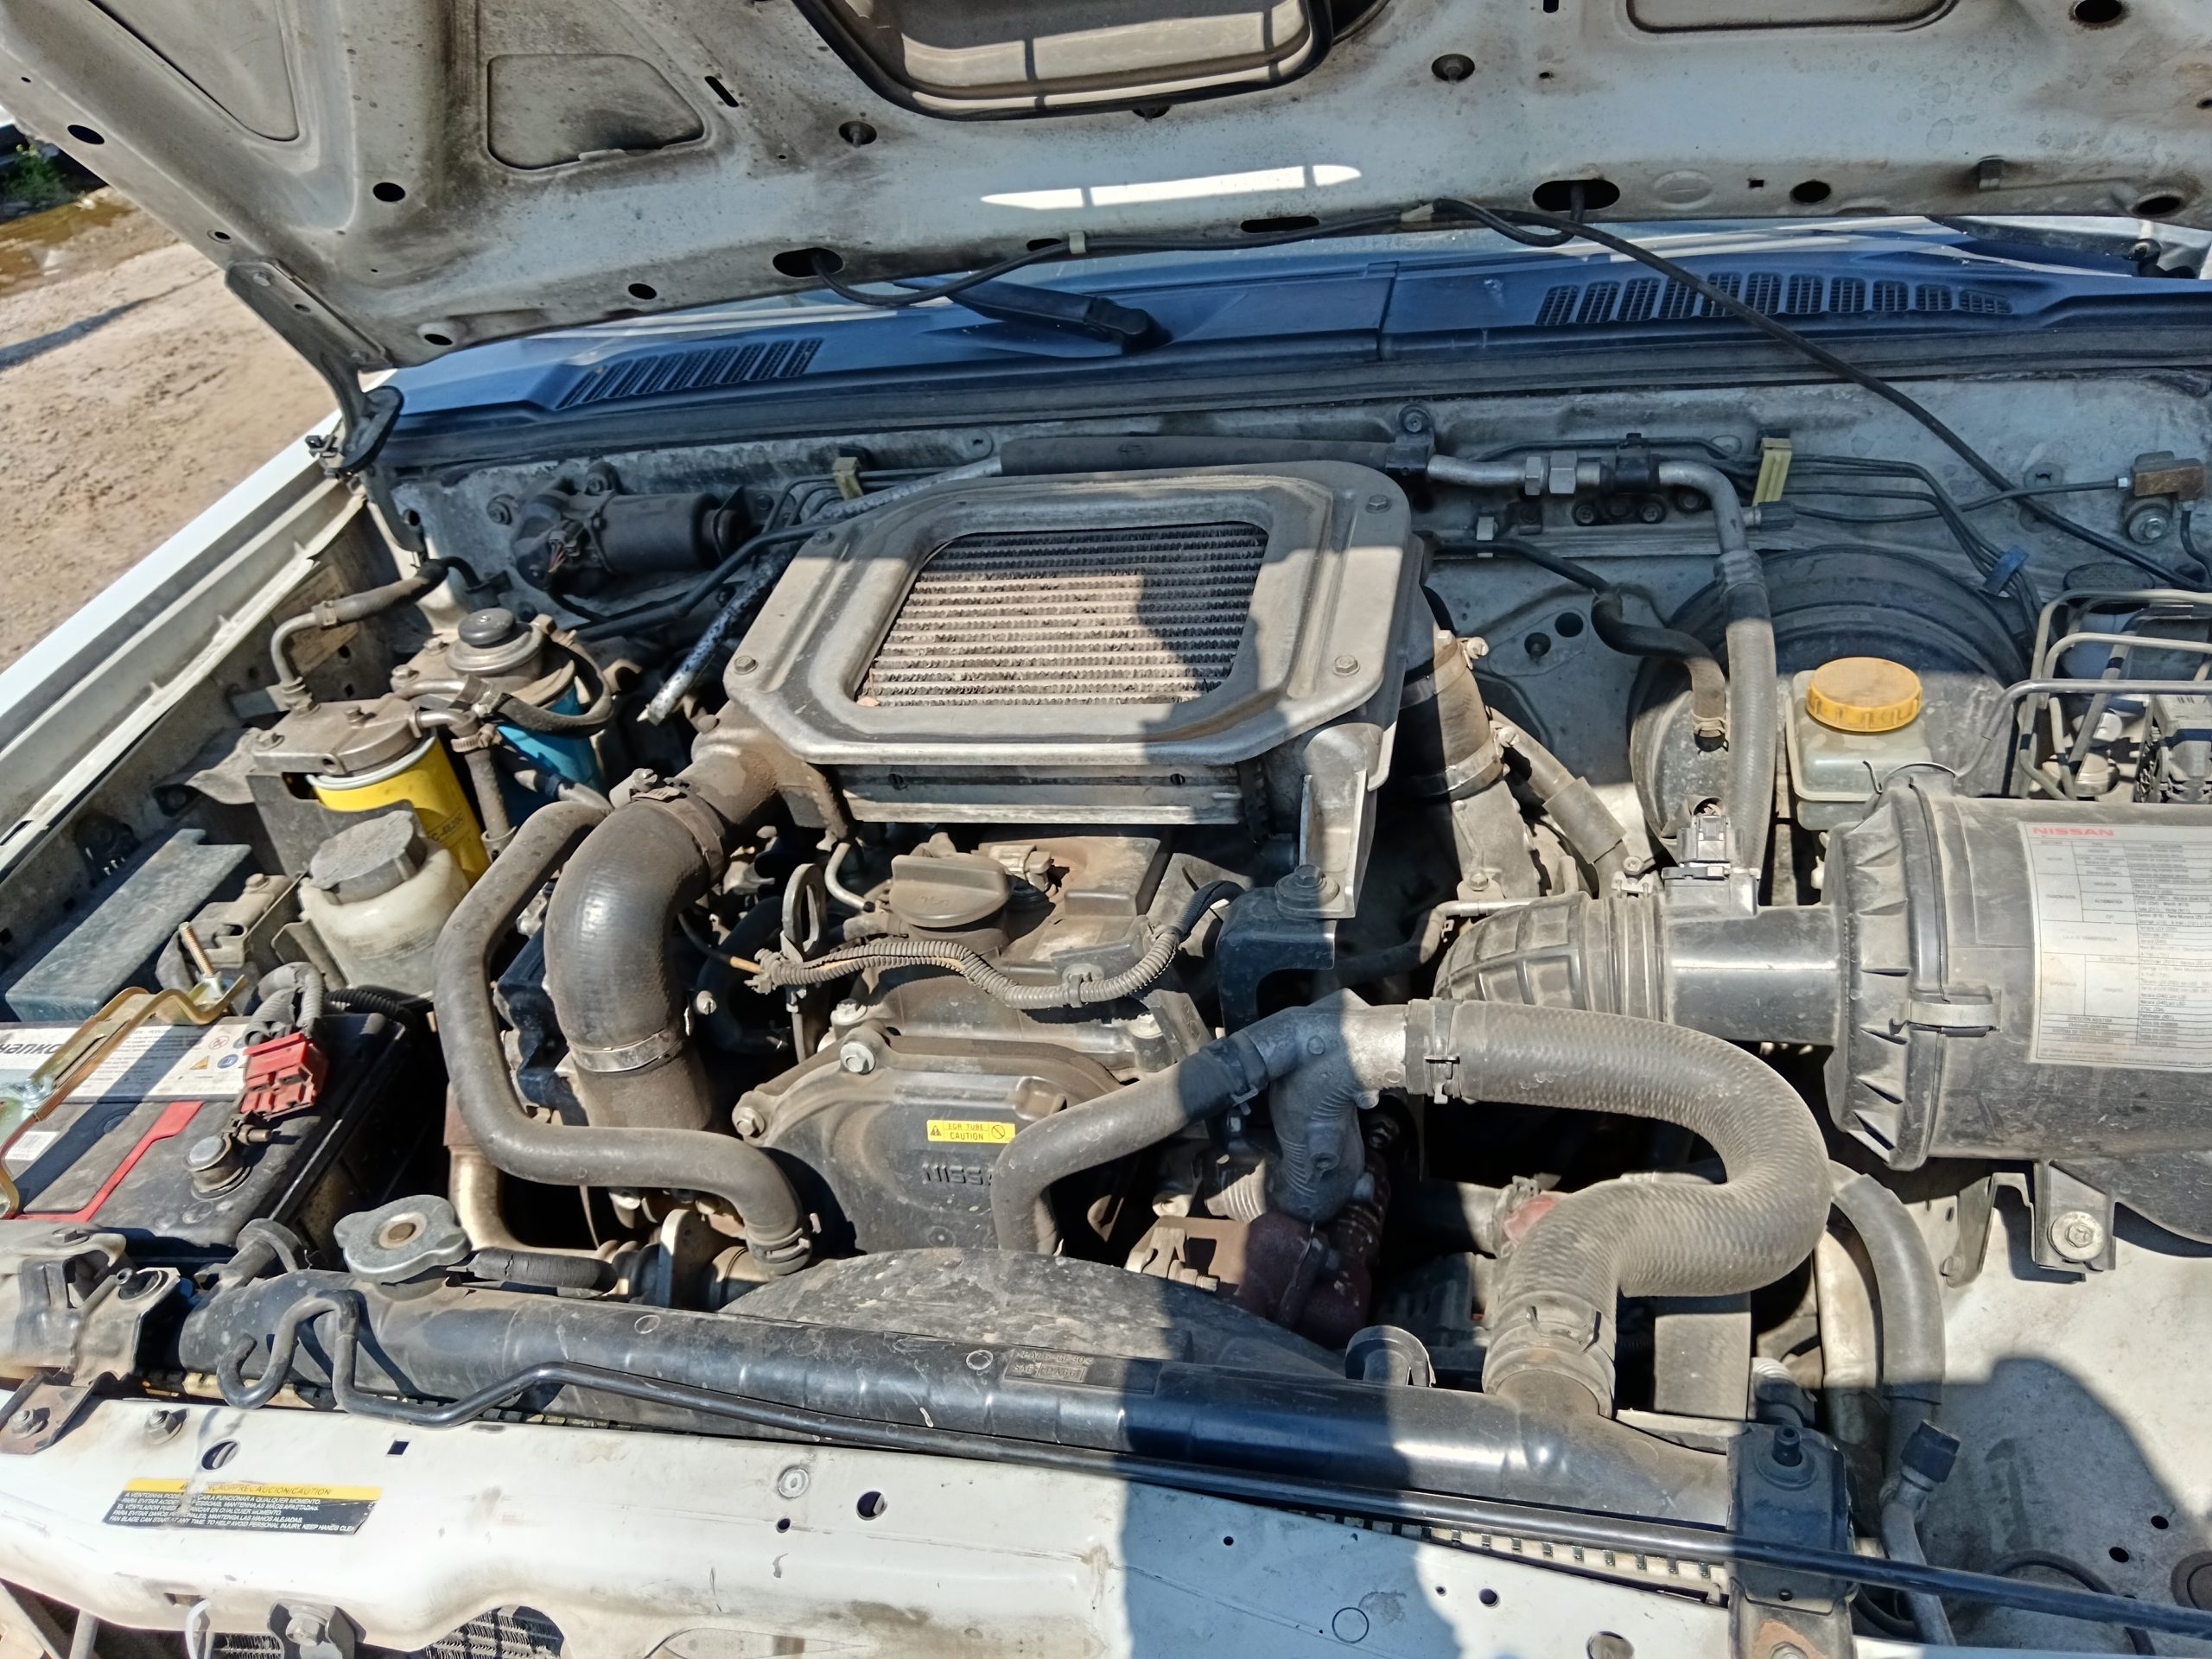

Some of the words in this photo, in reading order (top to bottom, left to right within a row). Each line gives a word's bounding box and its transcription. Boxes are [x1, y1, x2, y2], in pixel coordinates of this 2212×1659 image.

[2032, 827, 2114, 836] NISSAN
[950, 1132, 984, 1141] CAUTION
[921, 1163, 992, 1185] NISS
